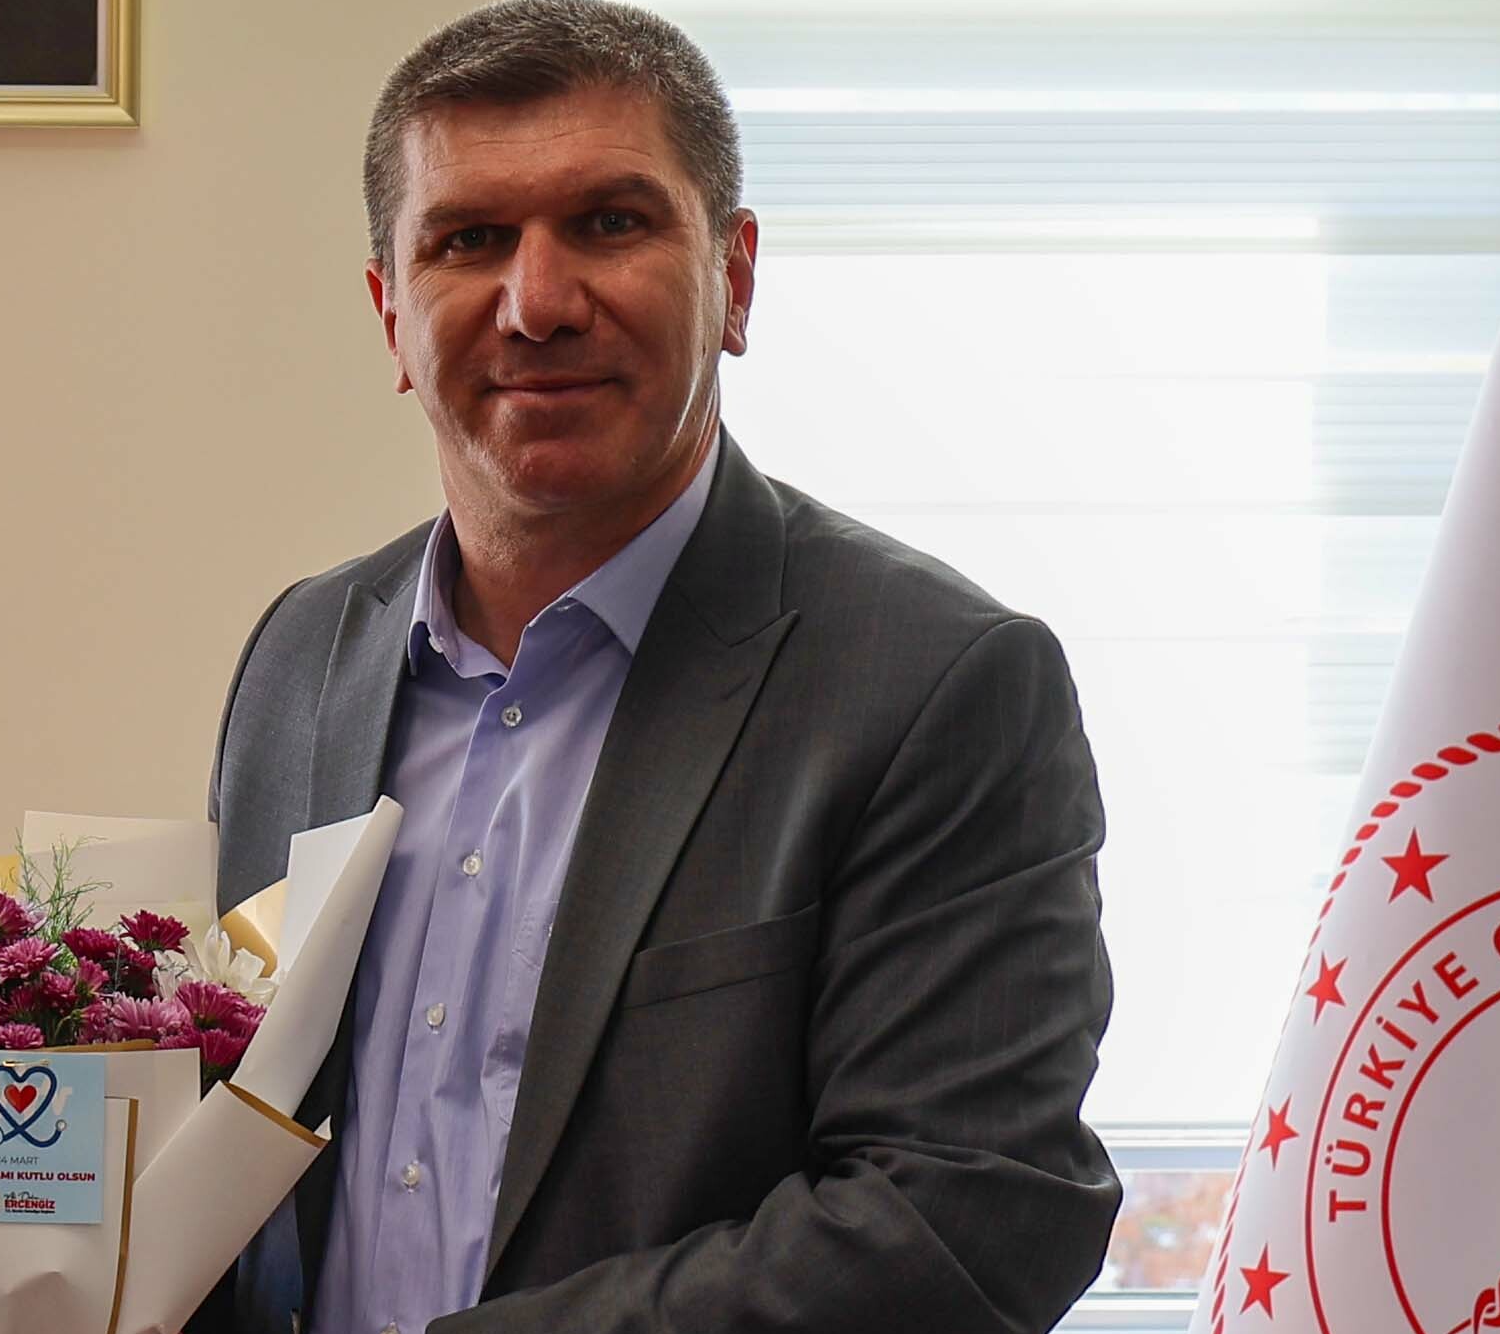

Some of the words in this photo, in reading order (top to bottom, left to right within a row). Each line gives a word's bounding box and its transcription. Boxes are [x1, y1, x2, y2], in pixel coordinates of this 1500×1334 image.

[1324, 951, 1480, 1223] TÜRKİYE
[10, 1156, 40, 1165] MART
[17, 1171, 55, 1181] KUTLU
[57, 1172, 96, 1182] OLSUN
